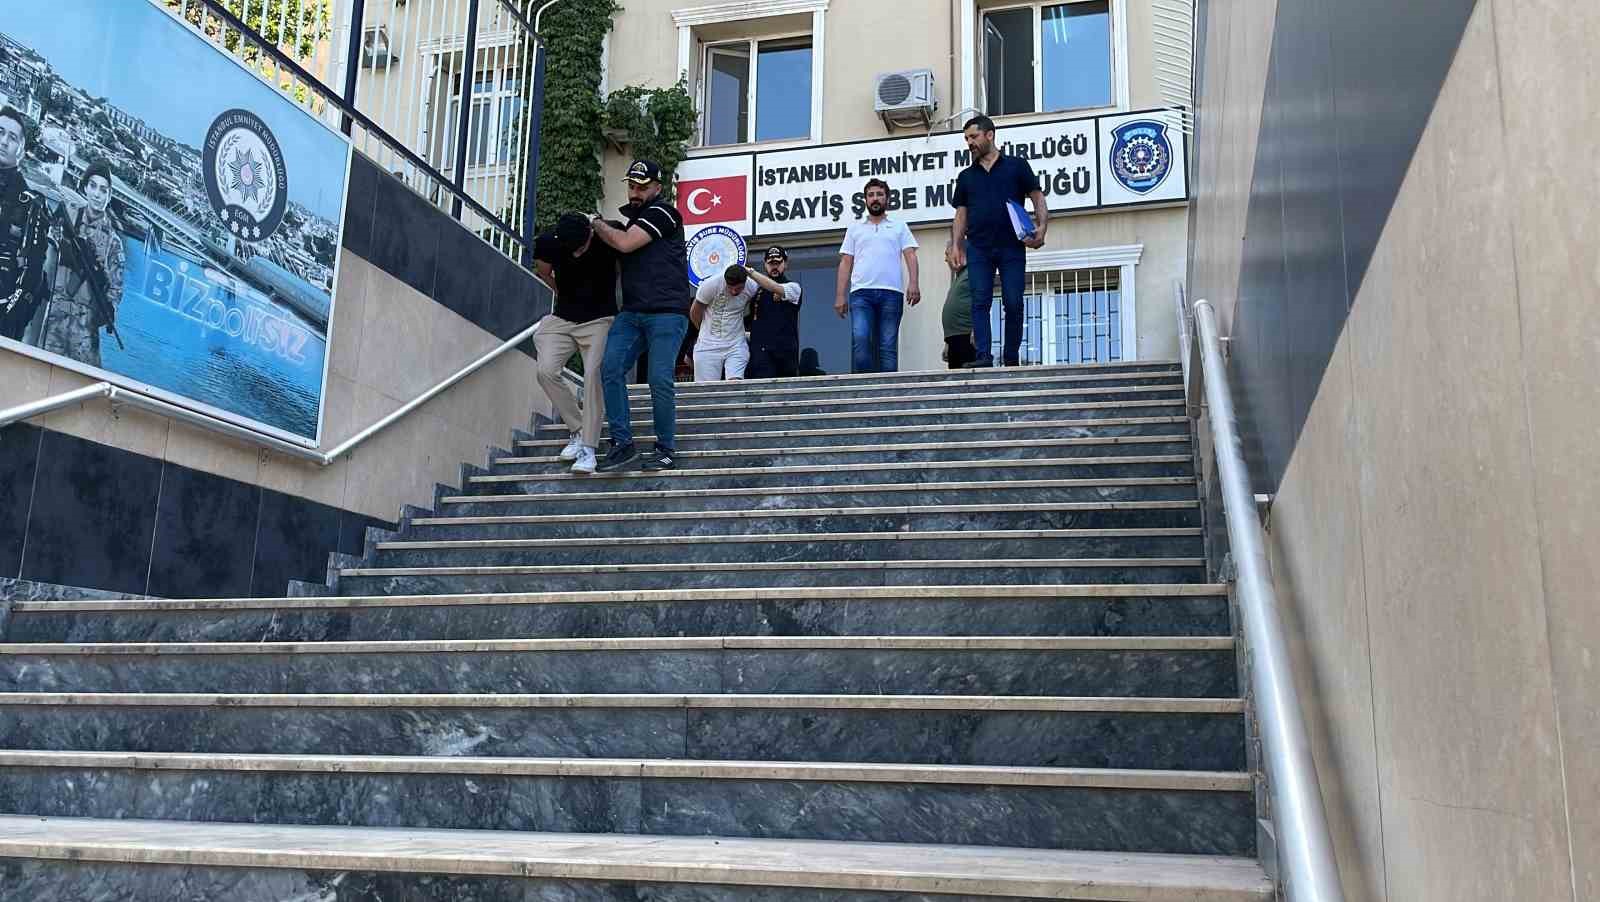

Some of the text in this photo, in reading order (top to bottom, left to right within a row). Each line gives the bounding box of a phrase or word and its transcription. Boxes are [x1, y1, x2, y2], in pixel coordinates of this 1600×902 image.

[758, 133, 1088, 187] İSTANBUL EMNİYET MÜRLÜĞÜ
[758, 166, 1091, 222] ASAYİŞ ŞBE MÜÜĞÜ
